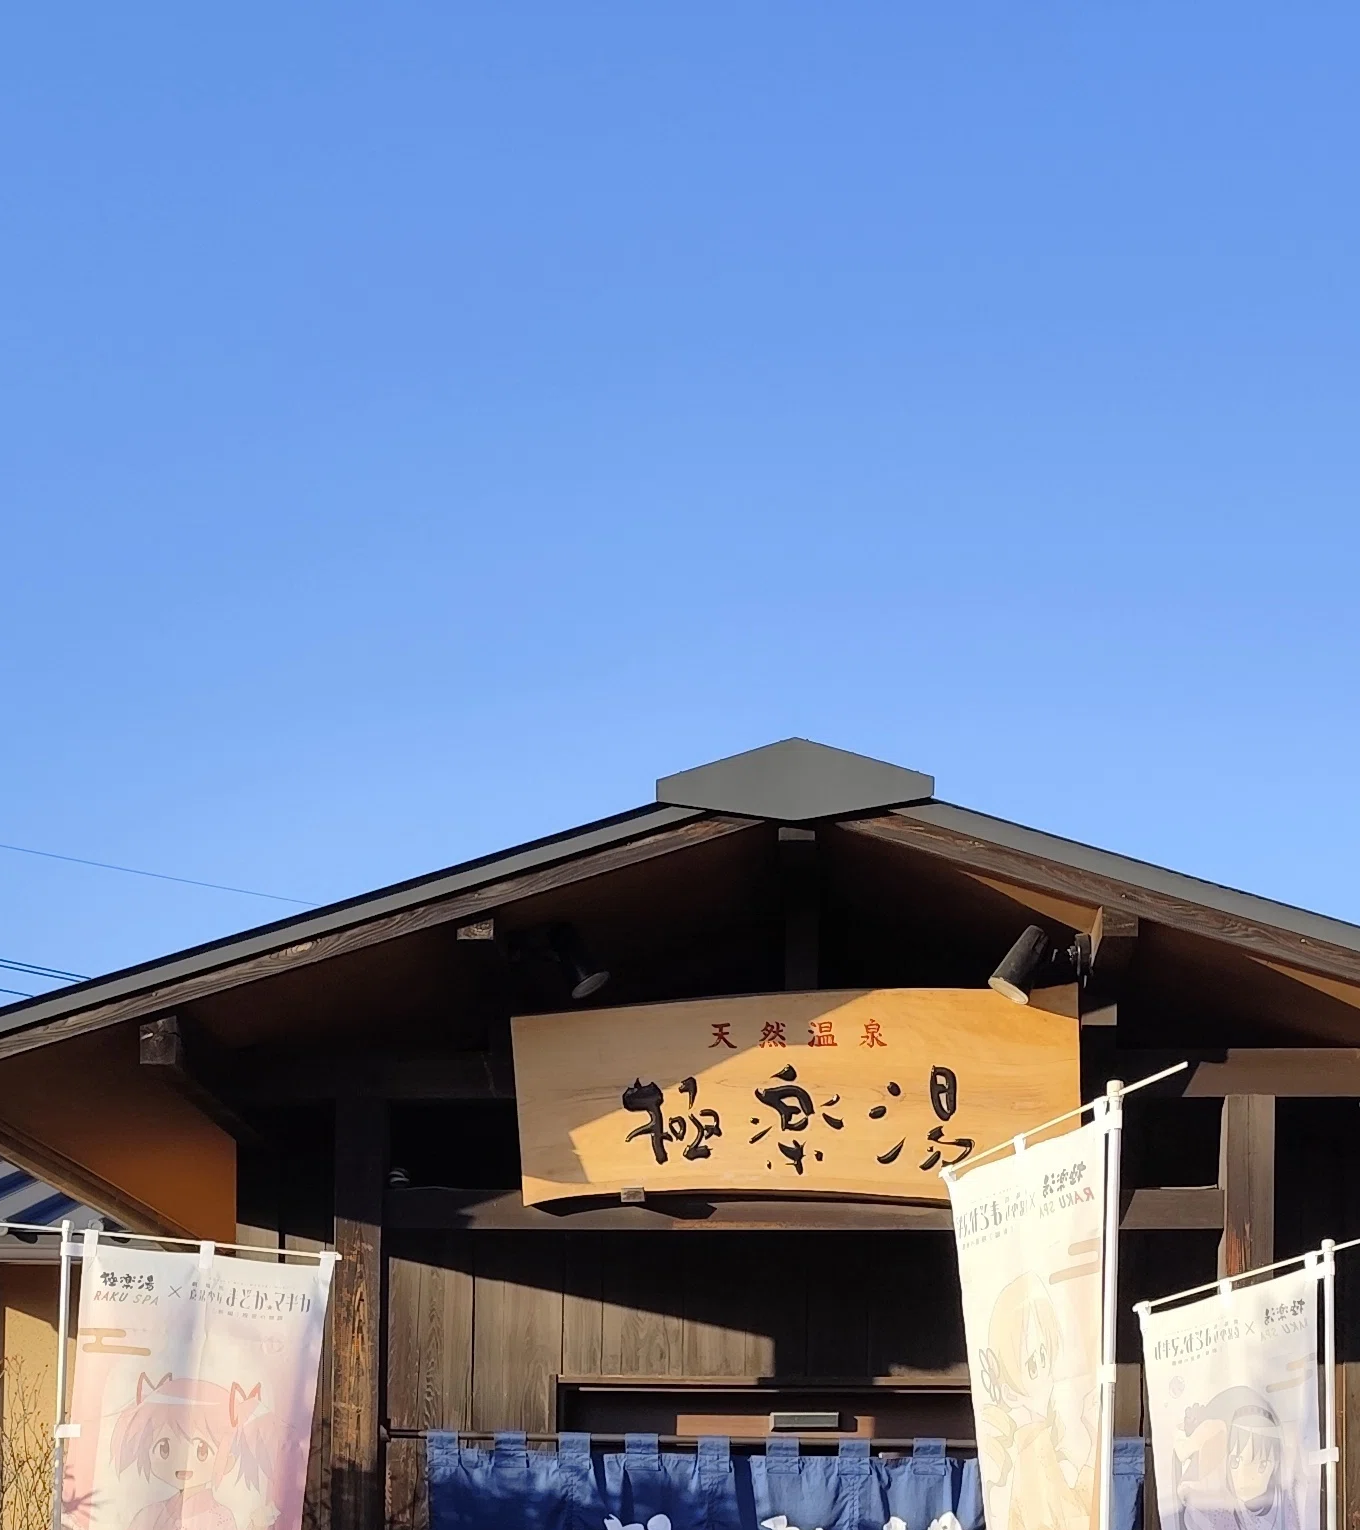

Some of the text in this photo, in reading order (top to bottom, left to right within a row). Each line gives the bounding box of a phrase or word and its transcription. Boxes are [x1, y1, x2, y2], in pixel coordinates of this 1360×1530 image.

[708, 1019, 888, 1049] 天然温泉
[622, 1063, 975, 1175] 極楽湯
[93, 1290, 159, 1306] RAKU SPA
